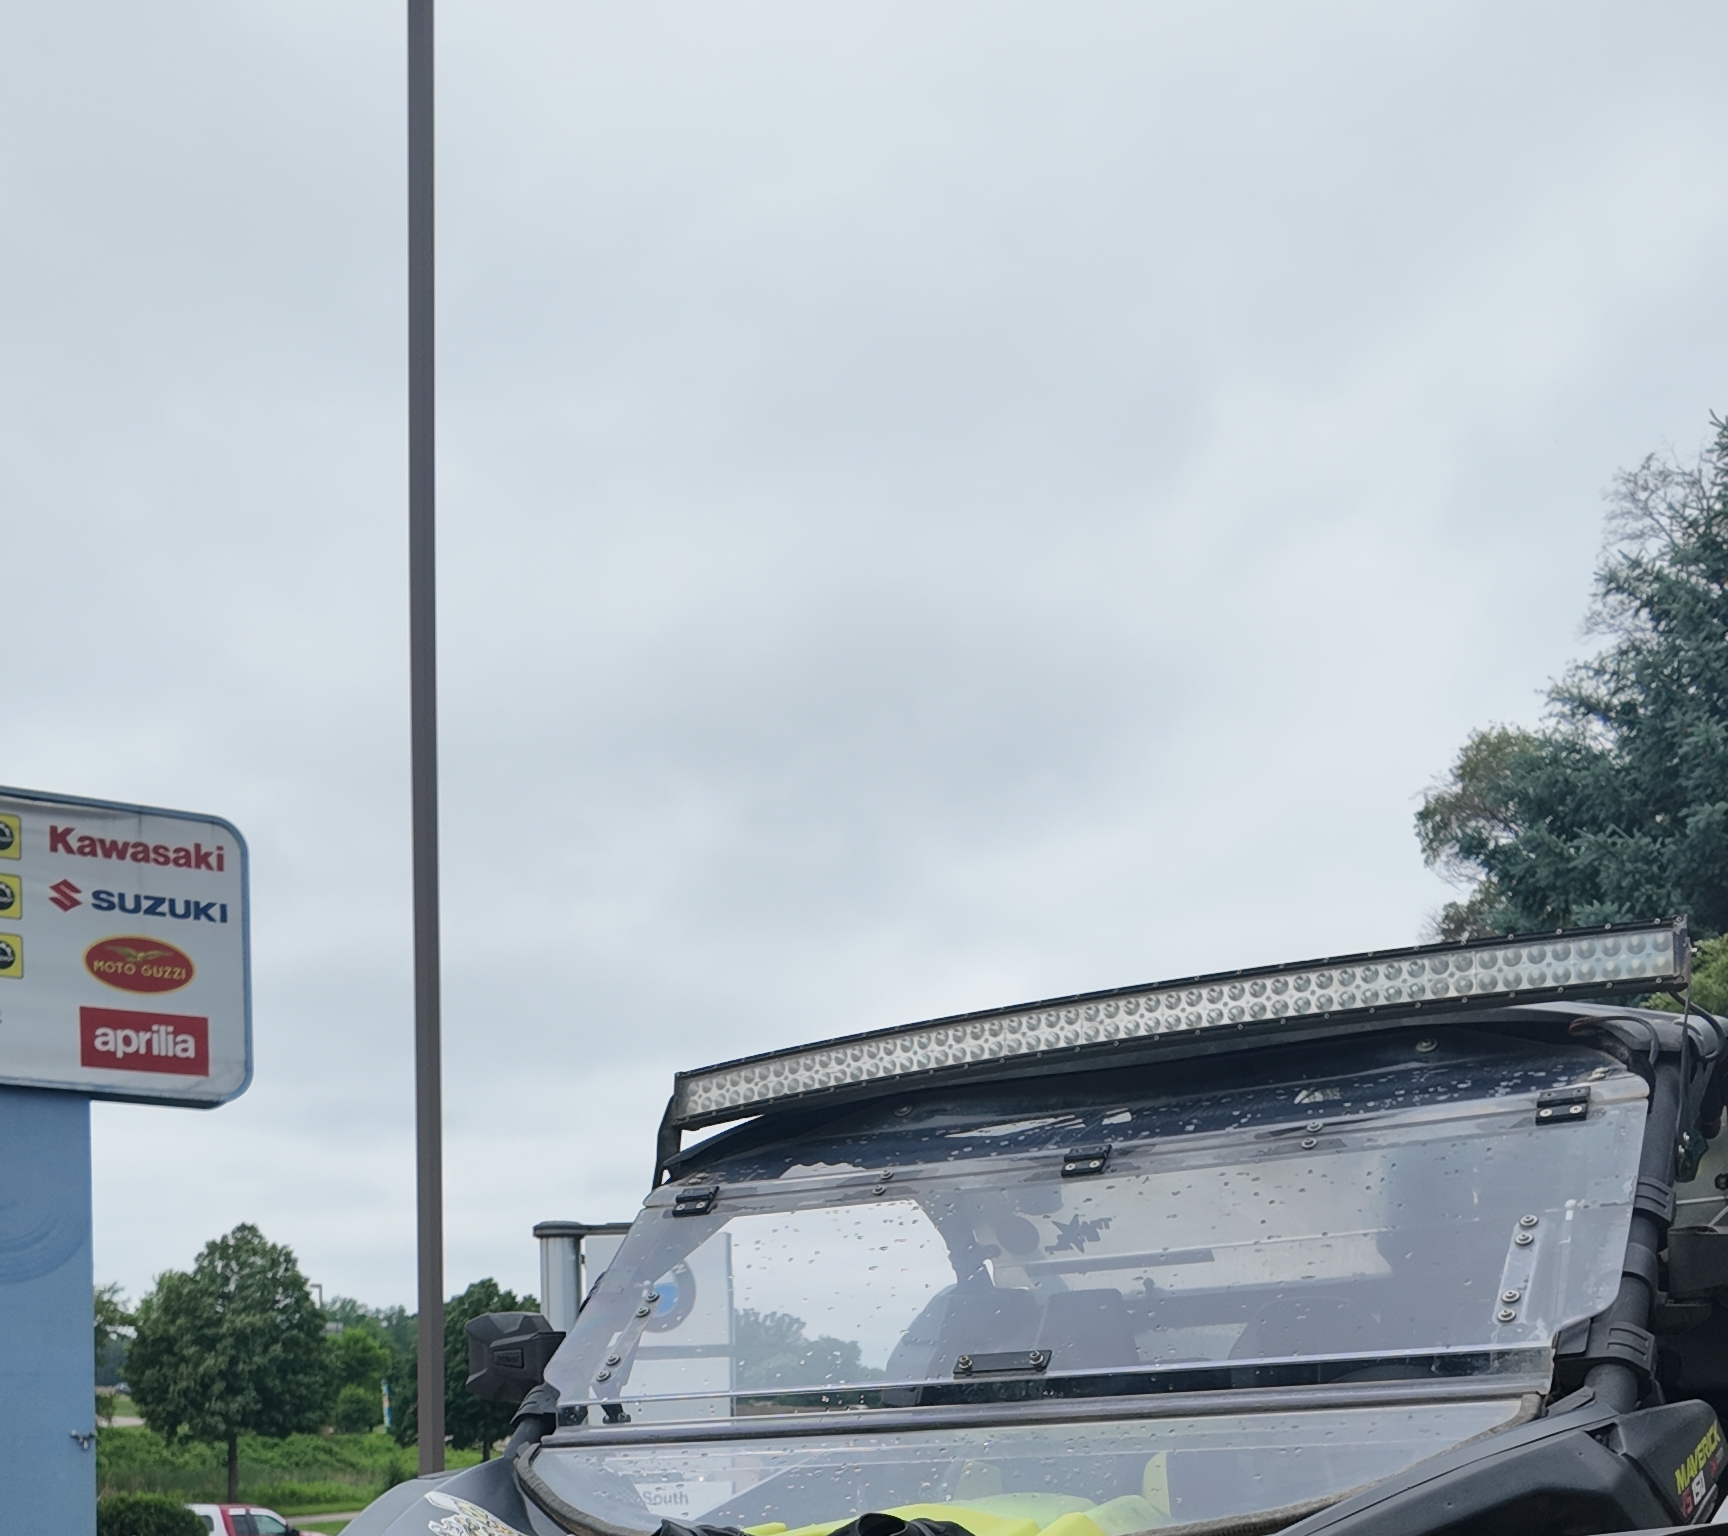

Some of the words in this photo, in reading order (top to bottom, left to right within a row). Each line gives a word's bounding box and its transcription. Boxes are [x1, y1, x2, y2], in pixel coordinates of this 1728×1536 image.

[49, 825, 225, 872] Kawasaki
[91, 889, 228, 923] SUZUKI
[93, 960, 136, 976] MOTO
[140, 964, 186, 981] GUZZI
[94, 1024, 196, 1059] aprilia
[642, 1490, 689, 1505] South
